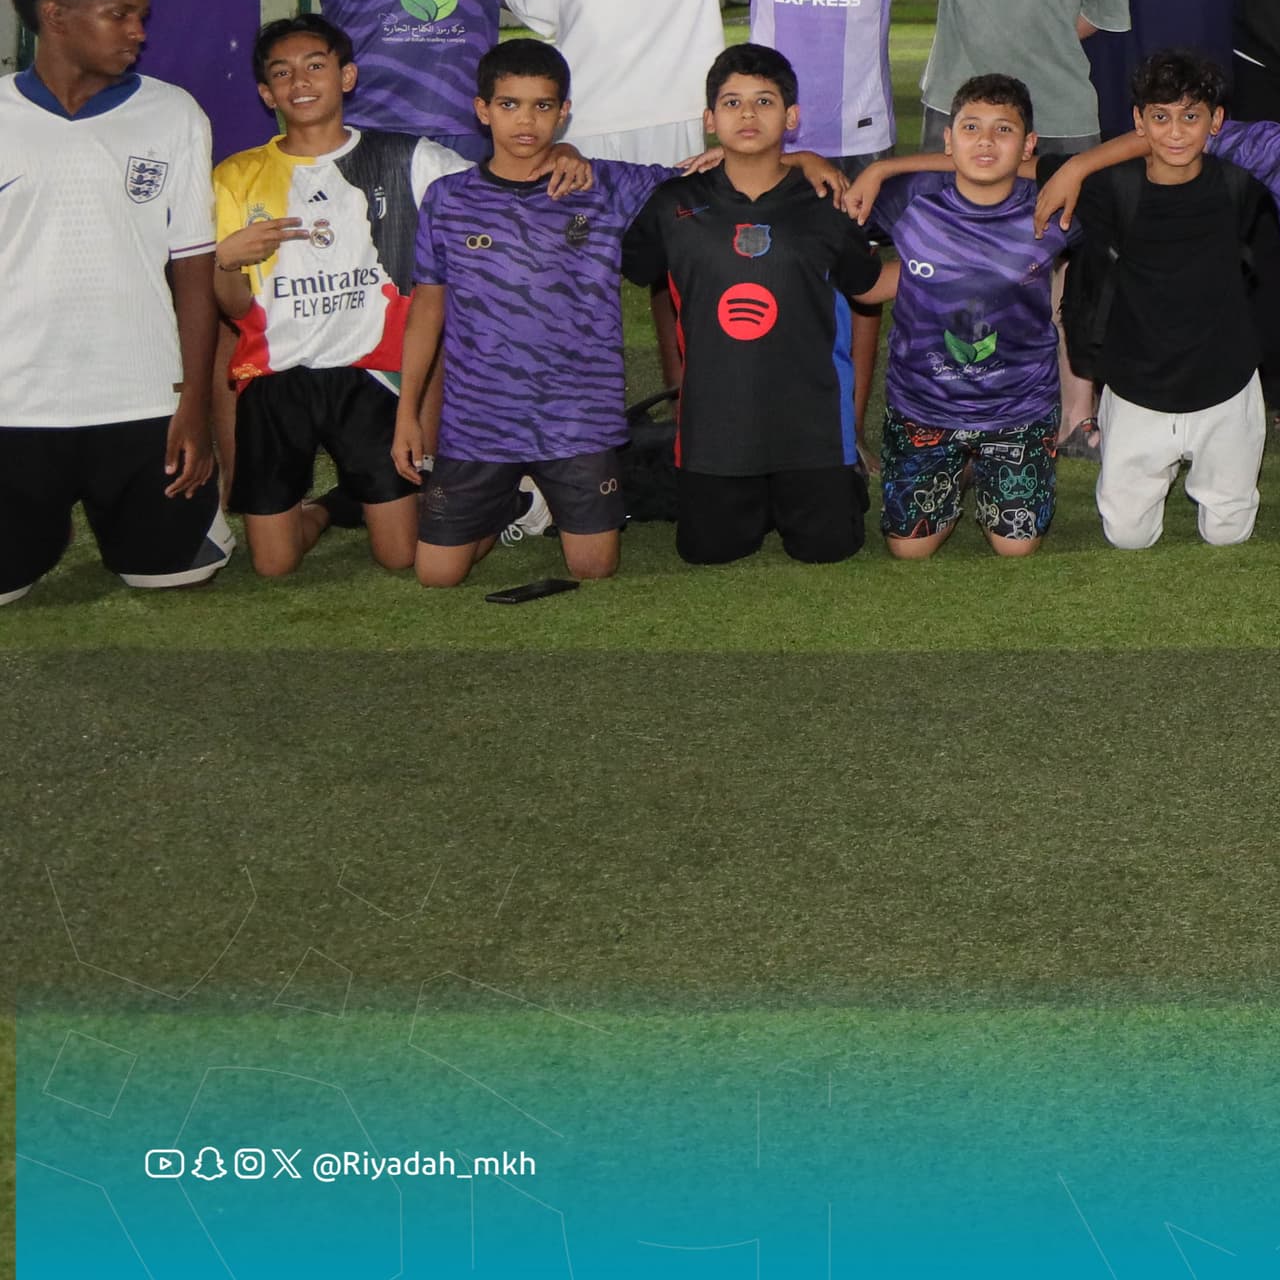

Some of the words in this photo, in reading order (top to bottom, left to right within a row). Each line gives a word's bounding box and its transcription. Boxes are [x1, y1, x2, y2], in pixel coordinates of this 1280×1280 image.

[273, 267, 380, 299] Emirates
[294, 297, 319, 319] FLY
[322, 290, 366, 315] BETTER
